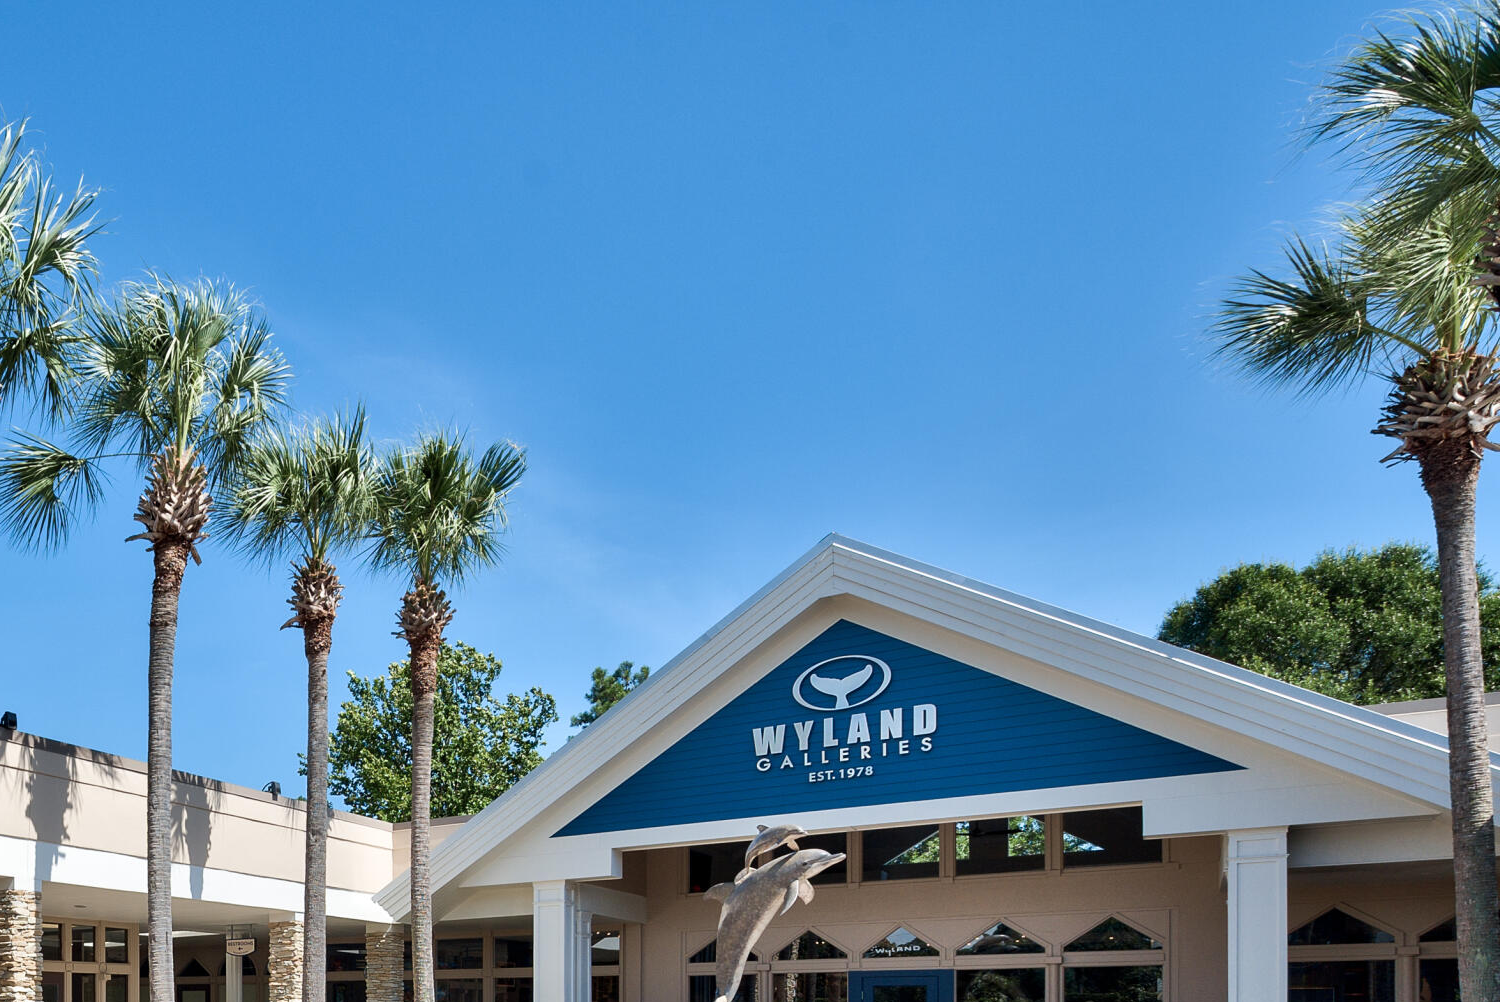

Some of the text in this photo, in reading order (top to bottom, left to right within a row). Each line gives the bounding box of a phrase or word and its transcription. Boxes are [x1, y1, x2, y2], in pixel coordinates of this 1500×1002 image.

[752, 703, 937, 757] WYLAND
[756, 737, 933, 772] GALLERIES
[808, 766, 874, 783] EST. 1978
